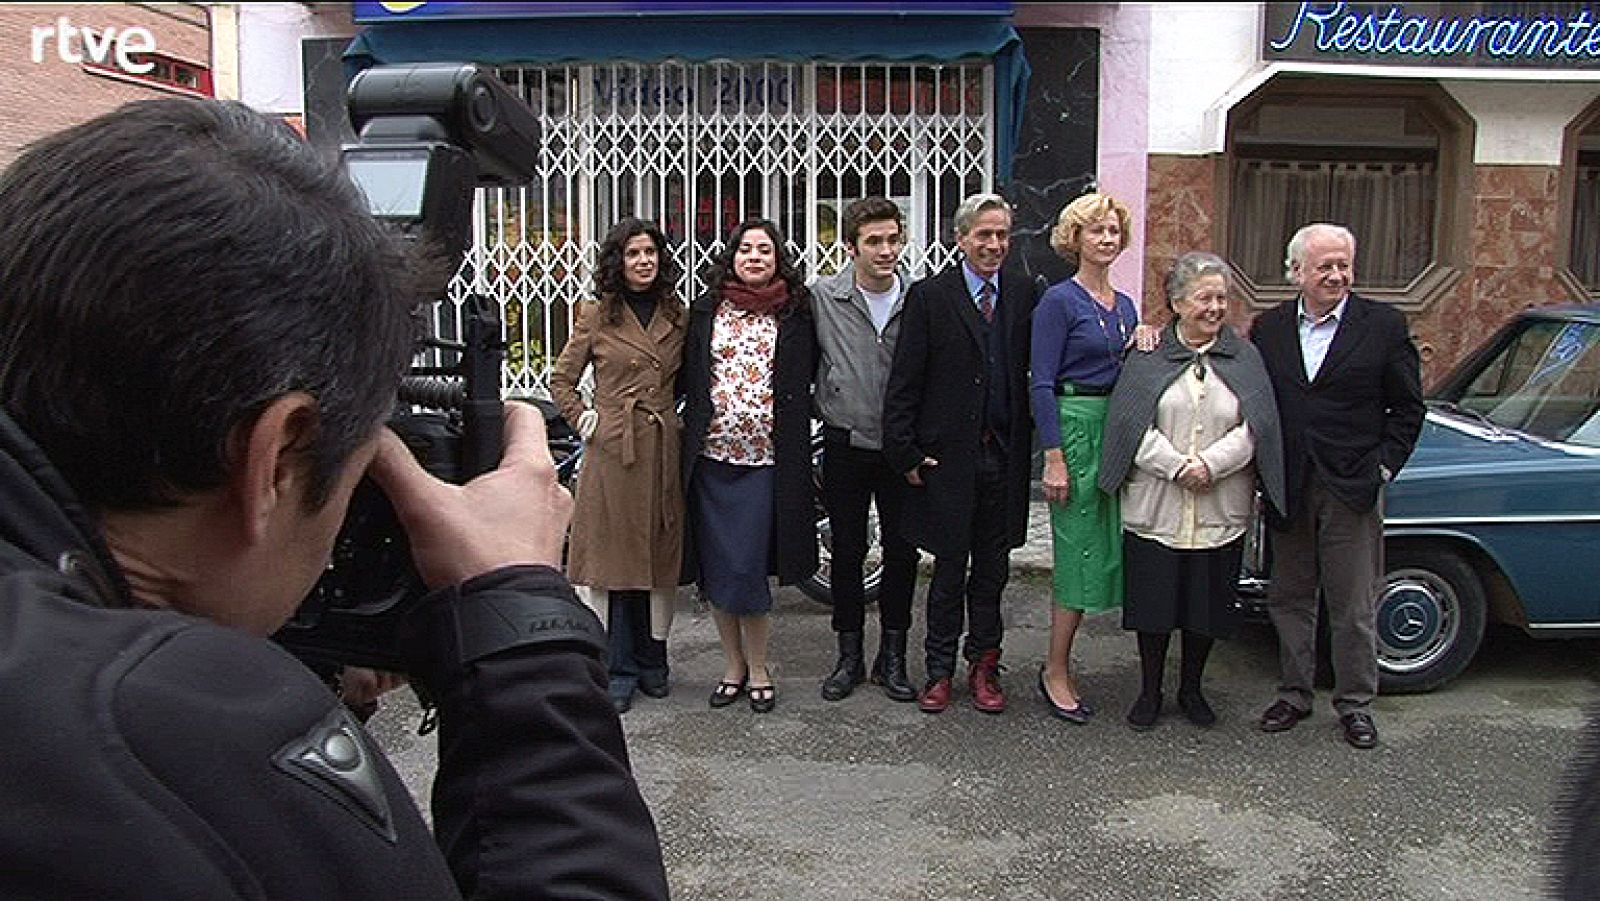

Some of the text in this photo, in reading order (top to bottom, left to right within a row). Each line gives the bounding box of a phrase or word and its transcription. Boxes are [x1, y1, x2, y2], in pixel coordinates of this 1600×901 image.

[1270, 2, 1600, 56] Restaurante
[594, 77, 693, 107] Video
[712, 76, 795, 107] 2000
